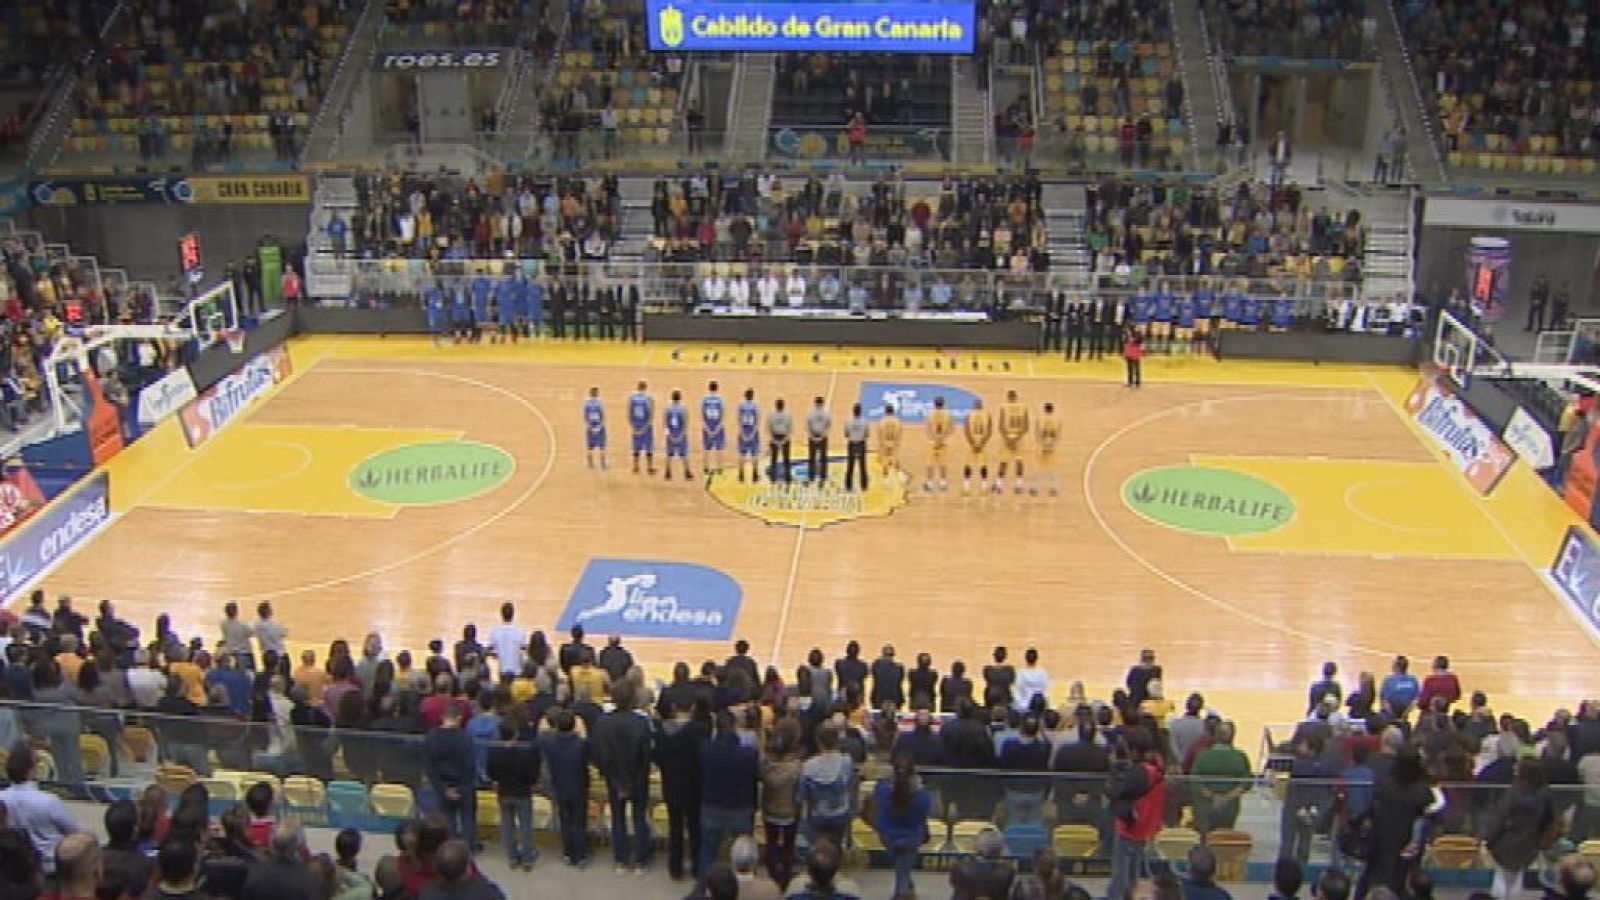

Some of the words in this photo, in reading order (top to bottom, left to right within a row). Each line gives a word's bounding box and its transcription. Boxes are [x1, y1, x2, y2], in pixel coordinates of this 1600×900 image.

[691, 13, 778, 38] Cabildo
[782, 14, 811, 38] de
[814, 15, 871, 38] Gran
[874, 16, 963, 41] Canaria
[217, 180, 248, 198] GRAN
[253, 180, 302, 198] CANARIA
[386, 461, 502, 486] HERBALIFE
[1161, 486, 1284, 521] HERBALIFE
[40, 496, 105, 562] endesa
[622, 602, 725, 627] endesa
